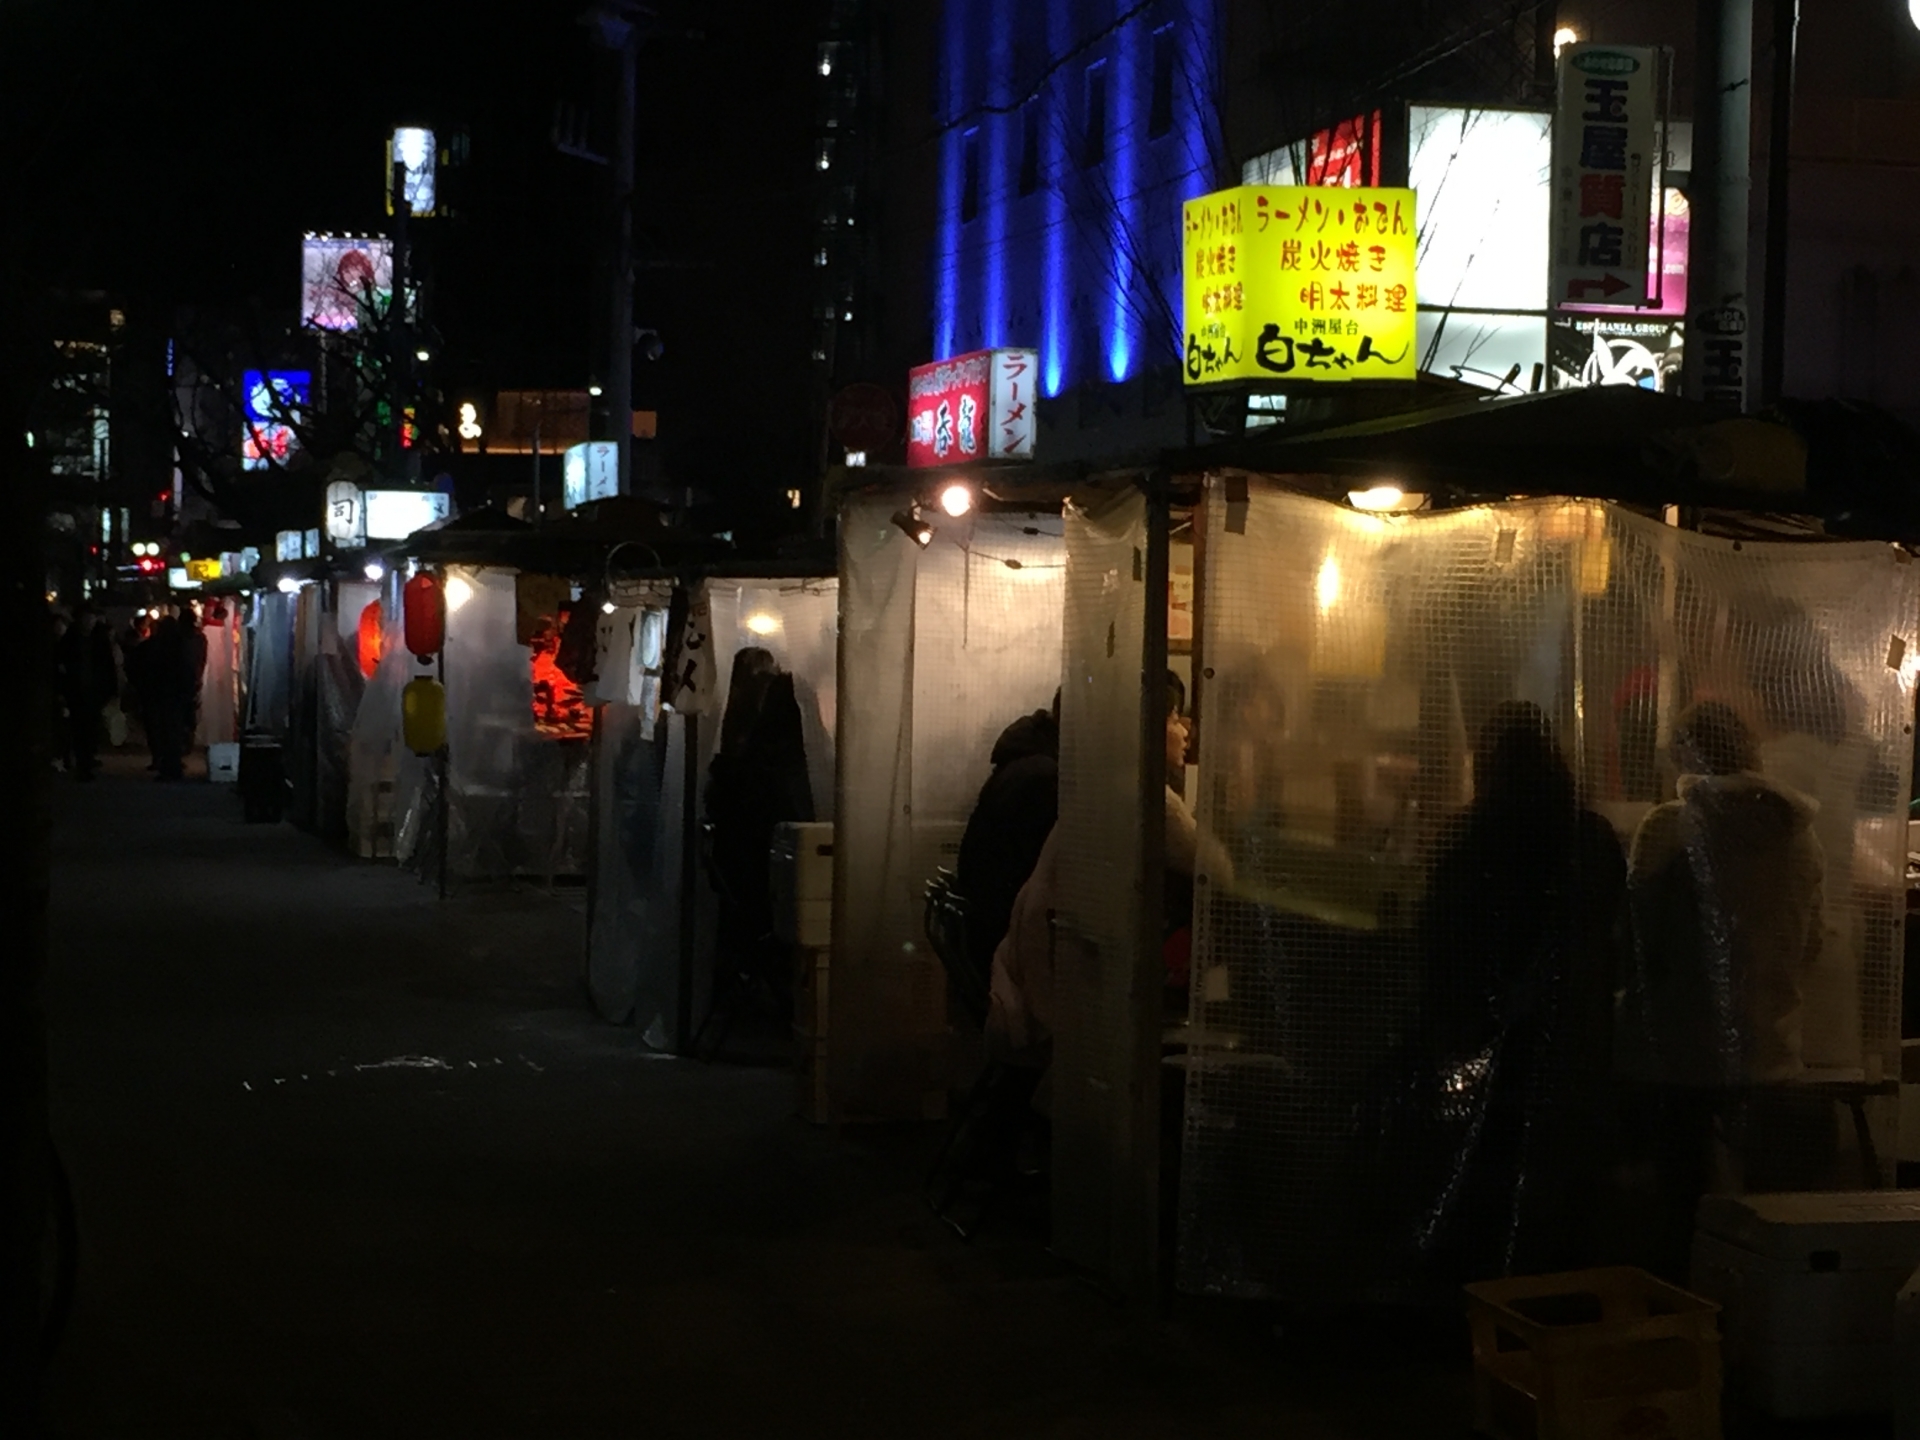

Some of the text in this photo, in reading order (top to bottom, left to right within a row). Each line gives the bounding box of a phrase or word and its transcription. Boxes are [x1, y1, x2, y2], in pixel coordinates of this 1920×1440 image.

[1580, 79, 1629, 266] 玉屋質店
[1281, 238, 1386, 272] 炭火焼き
[1300, 280, 1407, 312] 明太料理
[1294, 318, 1359, 335] 中洲屋台
[1187, 333, 1244, 380] 白ちゃん
[1255, 323, 1409, 373] 白ちゃん
[1000, 354, 1028, 454] ラーメン
[332, 498, 354, 525] 司
